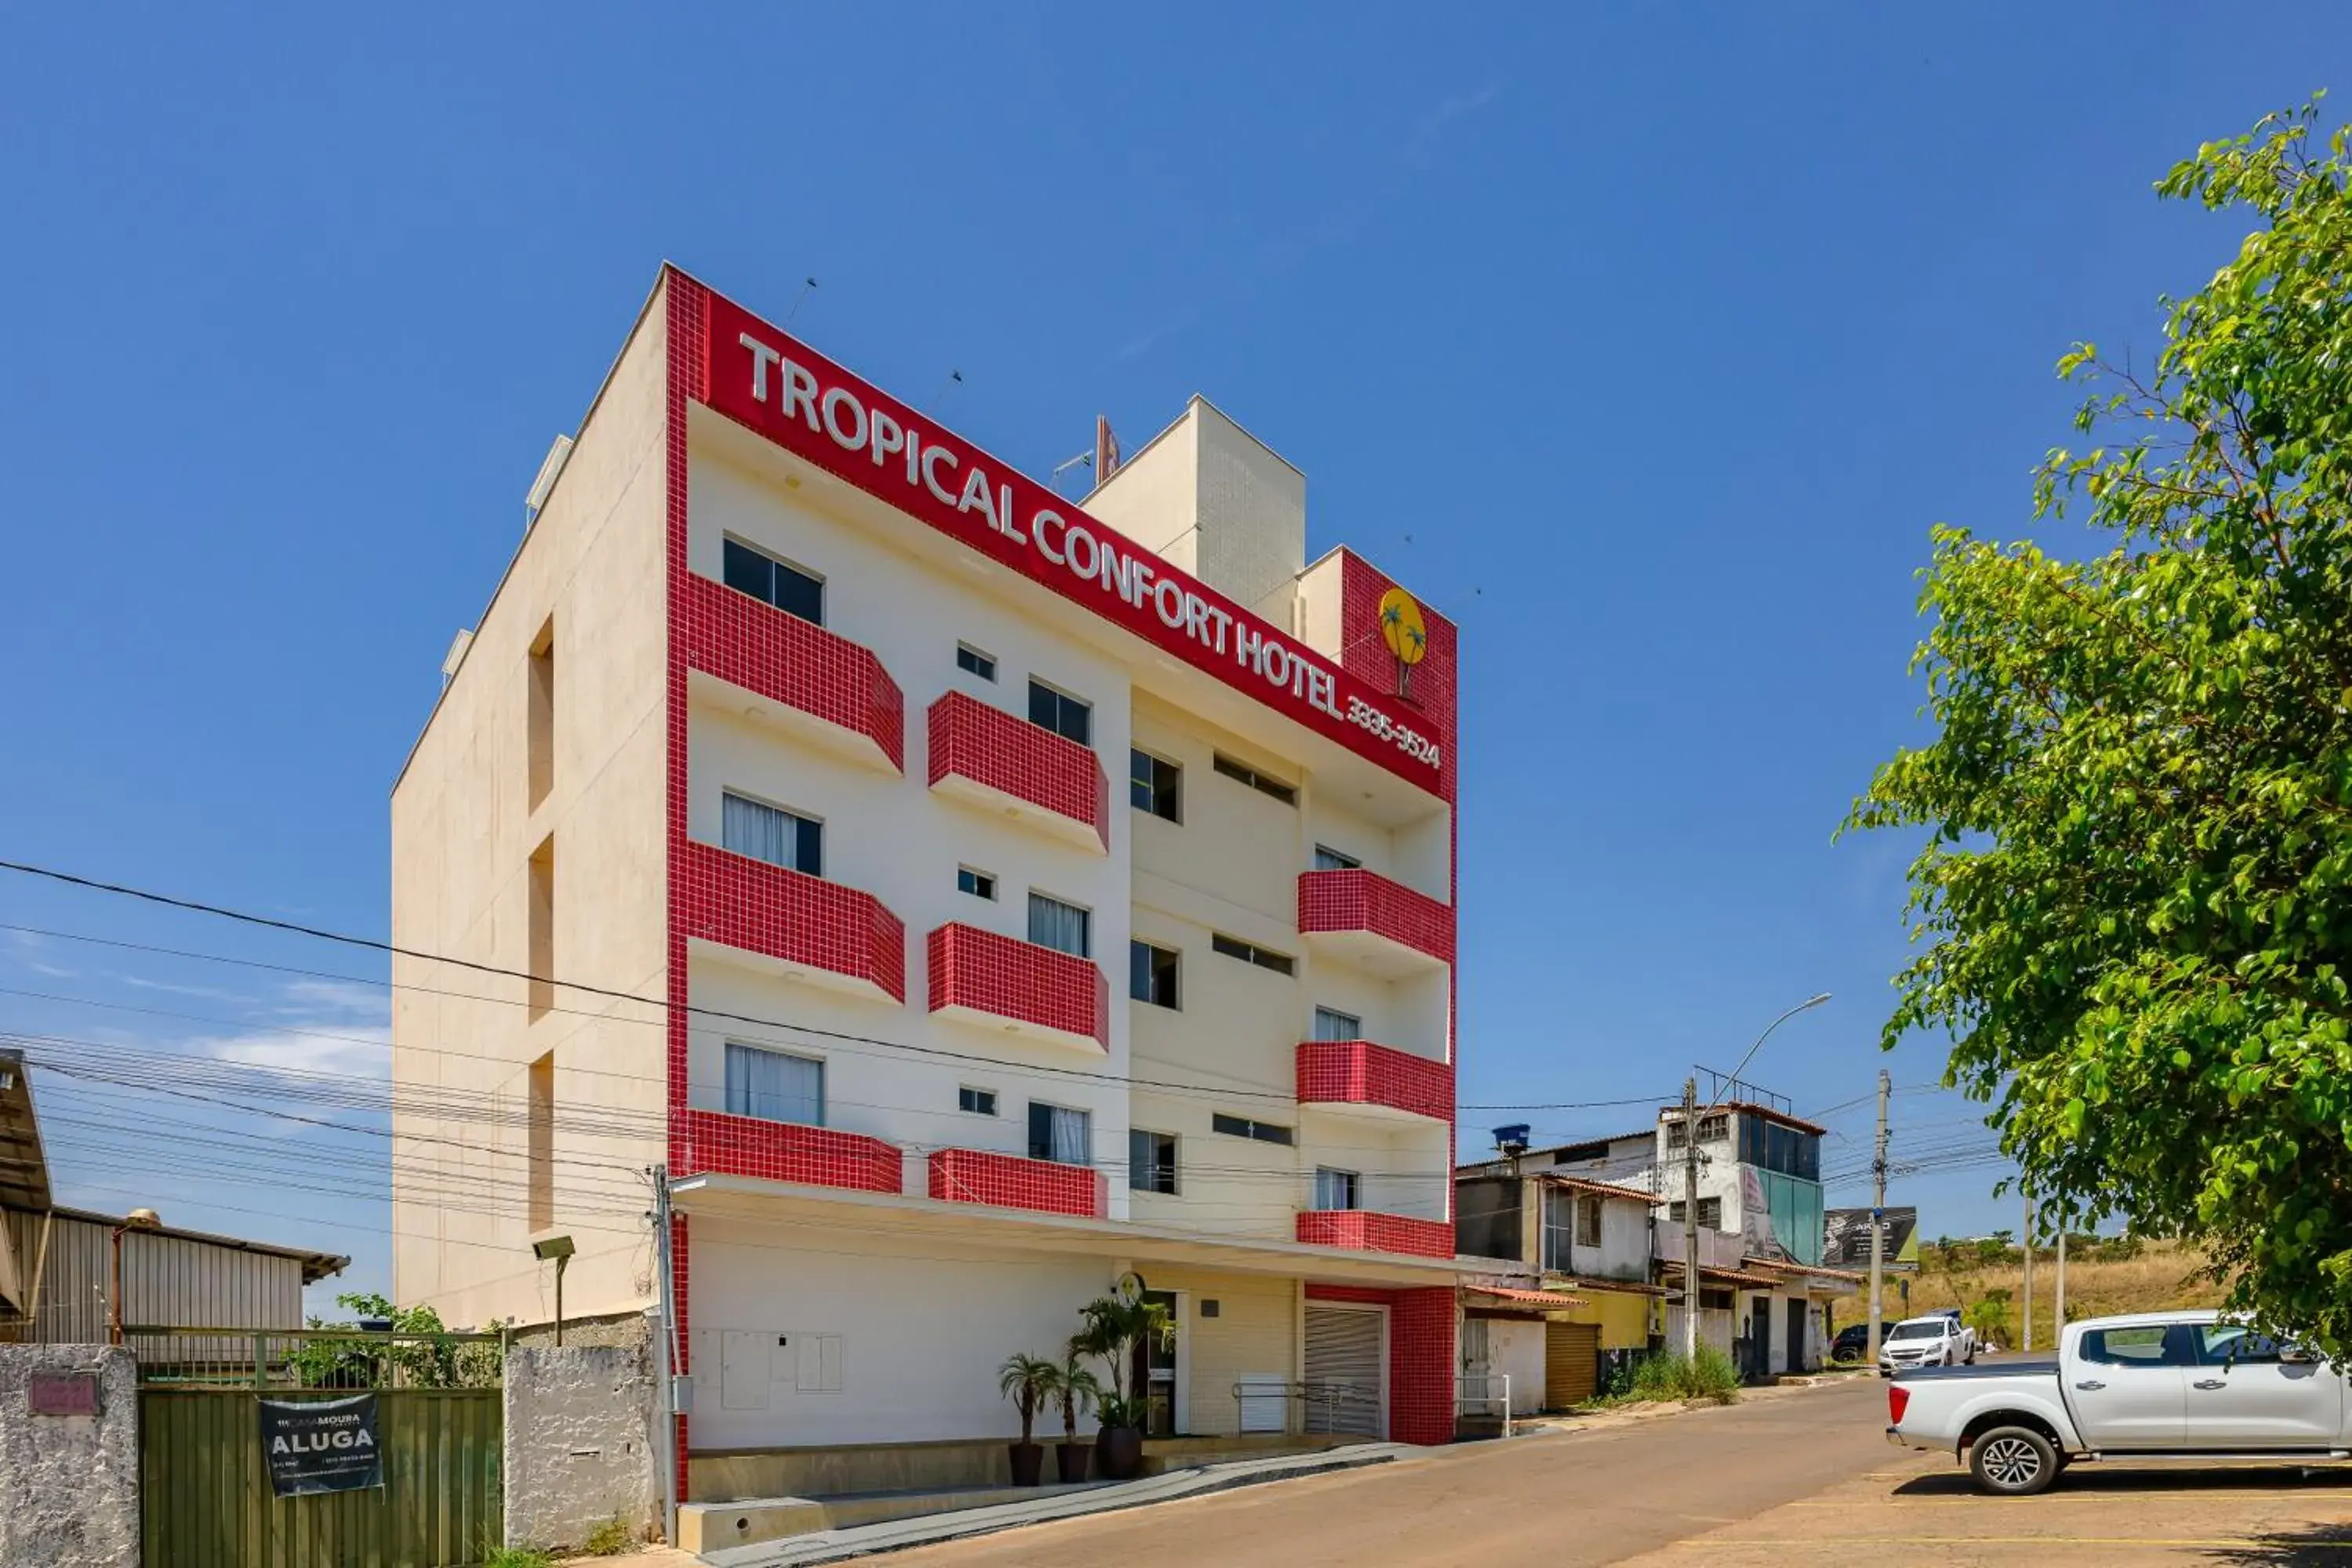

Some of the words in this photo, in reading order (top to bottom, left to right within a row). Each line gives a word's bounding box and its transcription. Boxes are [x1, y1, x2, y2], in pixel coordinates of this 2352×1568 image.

[739, 332, 1027, 546] TROPICAL
[1033, 510, 1232, 655] CONFORT
[1237, 621, 1344, 722] HOTEL
[1347, 695, 1440, 770] 3335-3524
[272, 1428, 374, 1454] ALUGA
